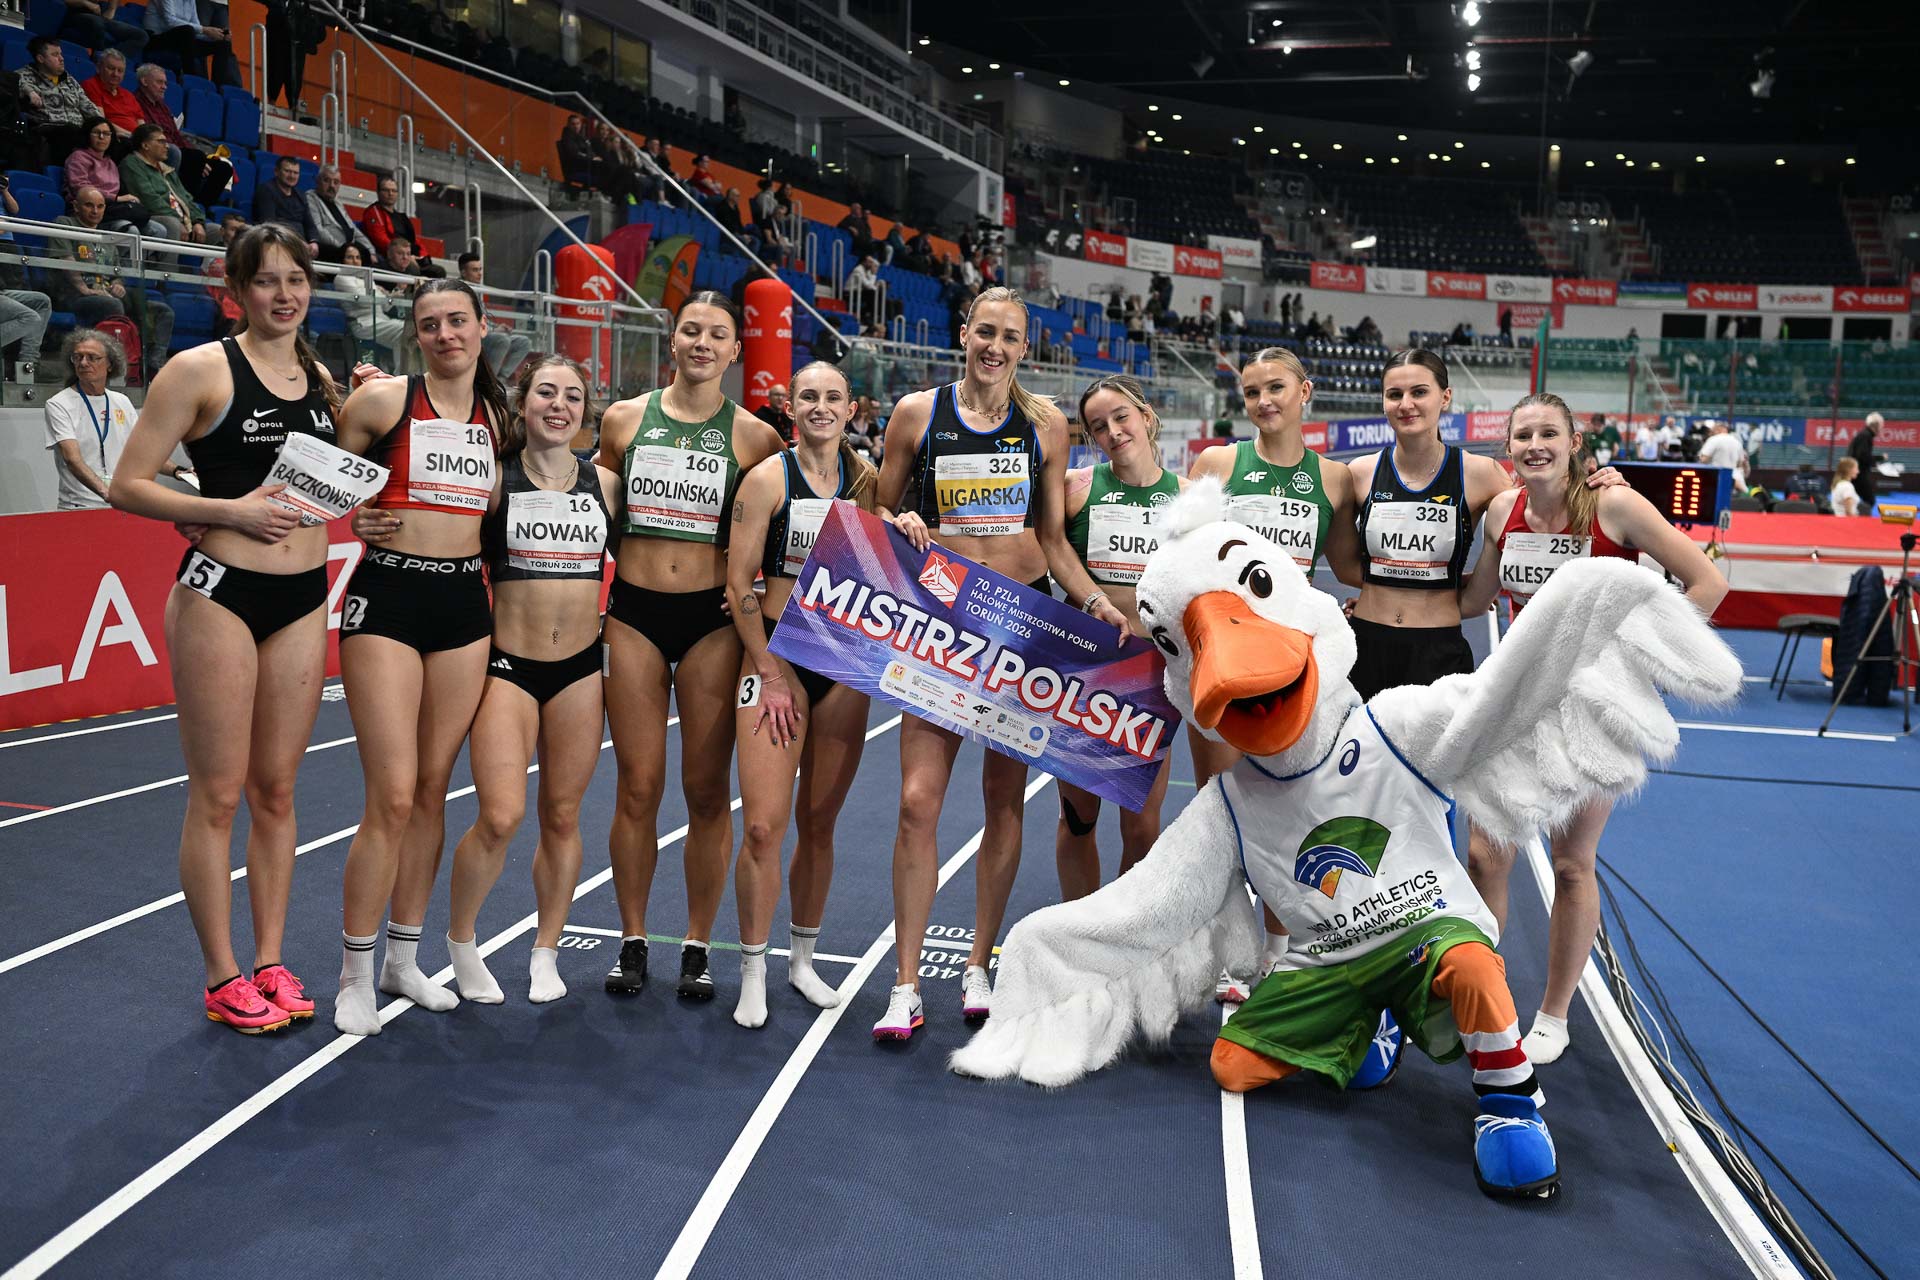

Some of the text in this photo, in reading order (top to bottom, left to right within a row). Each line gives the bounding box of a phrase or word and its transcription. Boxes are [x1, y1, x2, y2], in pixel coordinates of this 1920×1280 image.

[1317, 265, 1357, 283] PZLA
[1575, 285, 1612, 298] ORLEN
[1713, 289, 1753, 302] ORLEN
[1861, 293, 1905, 305] ORLEN
[248, 434, 285, 442] OPOLSKIE
[644, 427, 669, 440] 4F
[994, 439, 1026, 453] Sopot
[337, 457, 379, 484] 259
[426, 453, 489, 479] SIMON
[686, 455, 719, 473] 160
[989, 458, 1021, 474] 326
[1243, 471, 1267, 483] 4F
[434, 493, 463, 503] TORUŃ
[631, 477, 719, 506] ODOLIŃSKA
[940, 487, 1026, 507] LIGARSKA
[1100, 492, 1125, 503] 4F
[569, 498, 591, 513] 16
[1280, 501, 1311, 518] 159
[646, 516, 696, 529] TORUŃ 2026
[1416, 506, 1448, 523] 328
[515, 522, 599, 543] NOWAK
[960, 525, 988, 533] TORUŃ
[1381, 532, 1437, 552] MLAK
[1549, 538, 1582, 555] 253
[402, 559, 456, 573] PRO
[530, 560, 581, 570] TORUŃ 2026
[1383, 567, 1409, 576] TORUŃ
[188, 559, 216, 590] 5
[1109, 571, 1136, 580] TORUŃ
[975, 577, 1021, 607] 70. PZLA
[348, 598, 361, 628] 2
[965, 600, 1032, 640] TORUŃ 2026
[970, 589, 1098, 653] HALOWE MISTRZOSTWA POLSKI
[803, 566, 1167, 761] MISTRZ POLSKI
[741, 677, 755, 705] 3
[973, 704, 992, 715] 4F
[1352, 870, 1438, 922] ATHLETICS
[1345, 885, 1442, 939] CHAMPIONSHIPS
